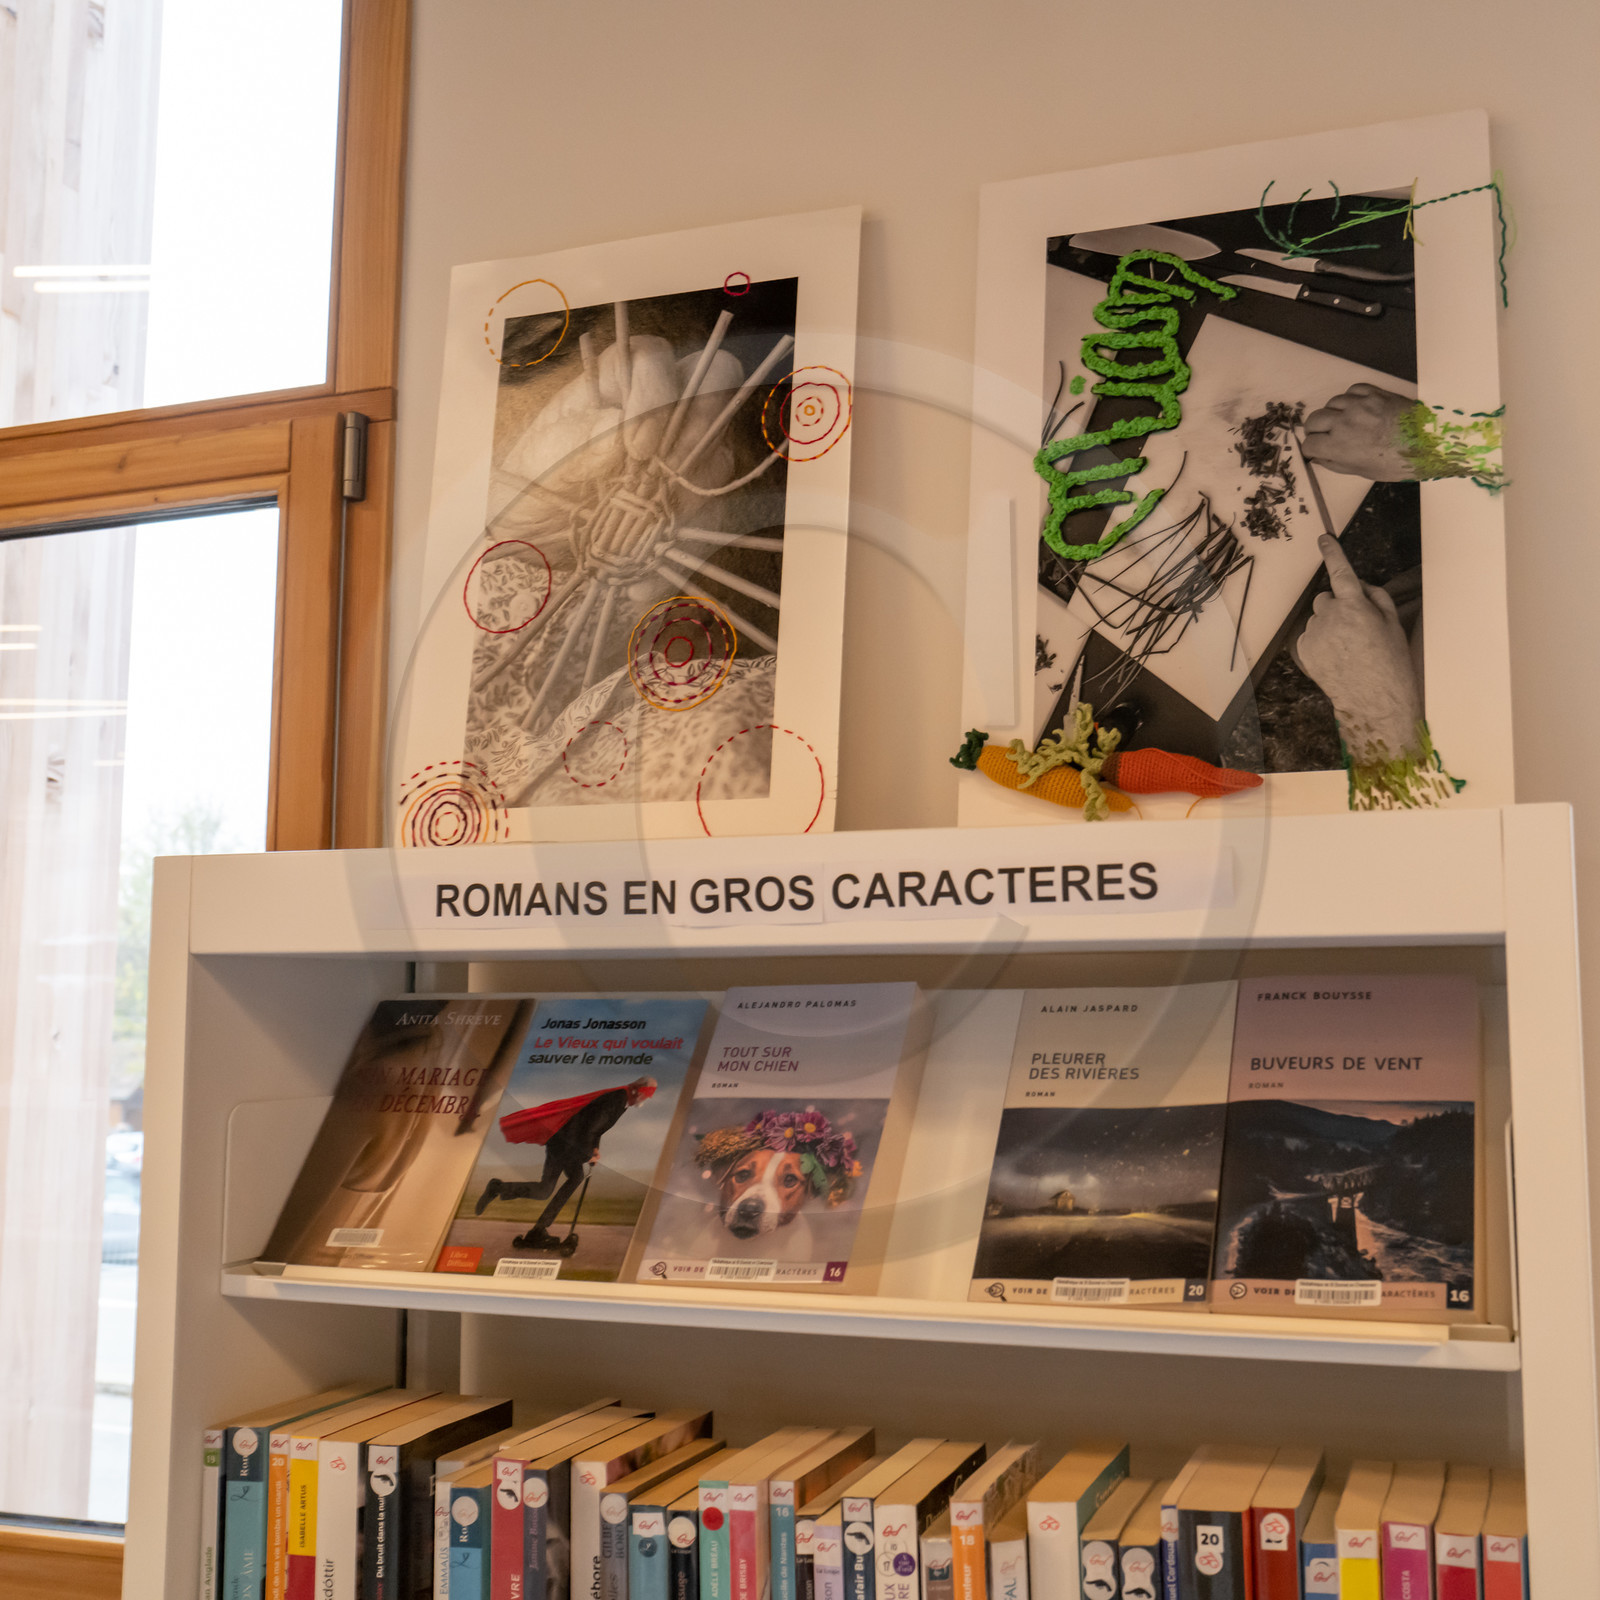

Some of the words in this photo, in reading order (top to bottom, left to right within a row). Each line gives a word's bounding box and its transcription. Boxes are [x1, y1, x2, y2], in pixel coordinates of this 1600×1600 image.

[435, 880, 608, 918] ROMANS
[623, 880, 678, 916] EN
[689, 875, 816, 916] GROS
[831, 861, 1160, 910] CARACTERES
[1256, 991, 1307, 1002] FRANCK
[1312, 991, 1373, 1001] BOUYSSE
[737, 1000, 802, 1010] ALEJANDRO
[805, 999, 858, 1009] PALOMAS
[1040, 1005, 1078, 1014] ALAIN
[1083, 1004, 1139, 1013] JASPARD
[540, 1017, 581, 1031] Jonas
[582, 1017, 647, 1031] Jonasson
[533, 1036, 554, 1050] Le
[556, 1036, 599, 1050] Vieux
[602, 1036, 628, 1051] qui
[628, 1036, 685, 1050] voulait
[527, 1054, 579, 1065] sauver
[580, 1051, 595, 1065] le
[597, 1051, 654, 1066] monde
[722, 1046, 760, 1058] TOUT
[761, 1046, 793, 1058] SUR
[1031, 1052, 1107, 1066] PLEURER
[716, 1059, 752, 1073] MON
[753, 1059, 800, 1073] CHIEN
[1250, 1056, 1335, 1072] BUVEURS
[1342, 1056, 1367, 1071] DE
[1374, 1056, 1424, 1071] VENT
[1028, 1067, 1060, 1081] DES
[1064, 1064, 1140, 1081] RIVIÈRES
[1248, 1082, 1285, 1090] ROMAN
[377, 1086, 474, 1114] DÉCEMBR
[672, 1265, 692, 1274] VOIR
[829, 1267, 842, 1278] 16
[1012, 1287, 1034, 1295] VOIR
[1036, 1287, 1048, 1295] DE
[1188, 1284, 1205, 1296] 20
[1253, 1286, 1280, 1295] VOIR
[1449, 1289, 1471, 1302] 16
[272, 1456, 283, 1467] 20
[274, 1481, 283, 1505] mardi
[299, 1484, 307, 1510] ARTUS
[376, 1512, 385, 1521] la
[776, 1507, 789, 1517] 16
[299, 1512, 307, 1549] ISABELLE
[376, 1521, 386, 1543] dans
[459, 1523, 469, 1543] Ro
[959, 1535, 975, 1546] 18
[1201, 1533, 1220, 1546] 20
[376, 1544, 386, 1565] bruit
[779, 1531, 788, 1565] Nantes
[854, 1553, 864, 1572] Bu
[376, 1566, 385, 1579] Du
[438, 1546, 449, 1595] EMMAÜS
[739, 1558, 747, 1589] BRISBY
